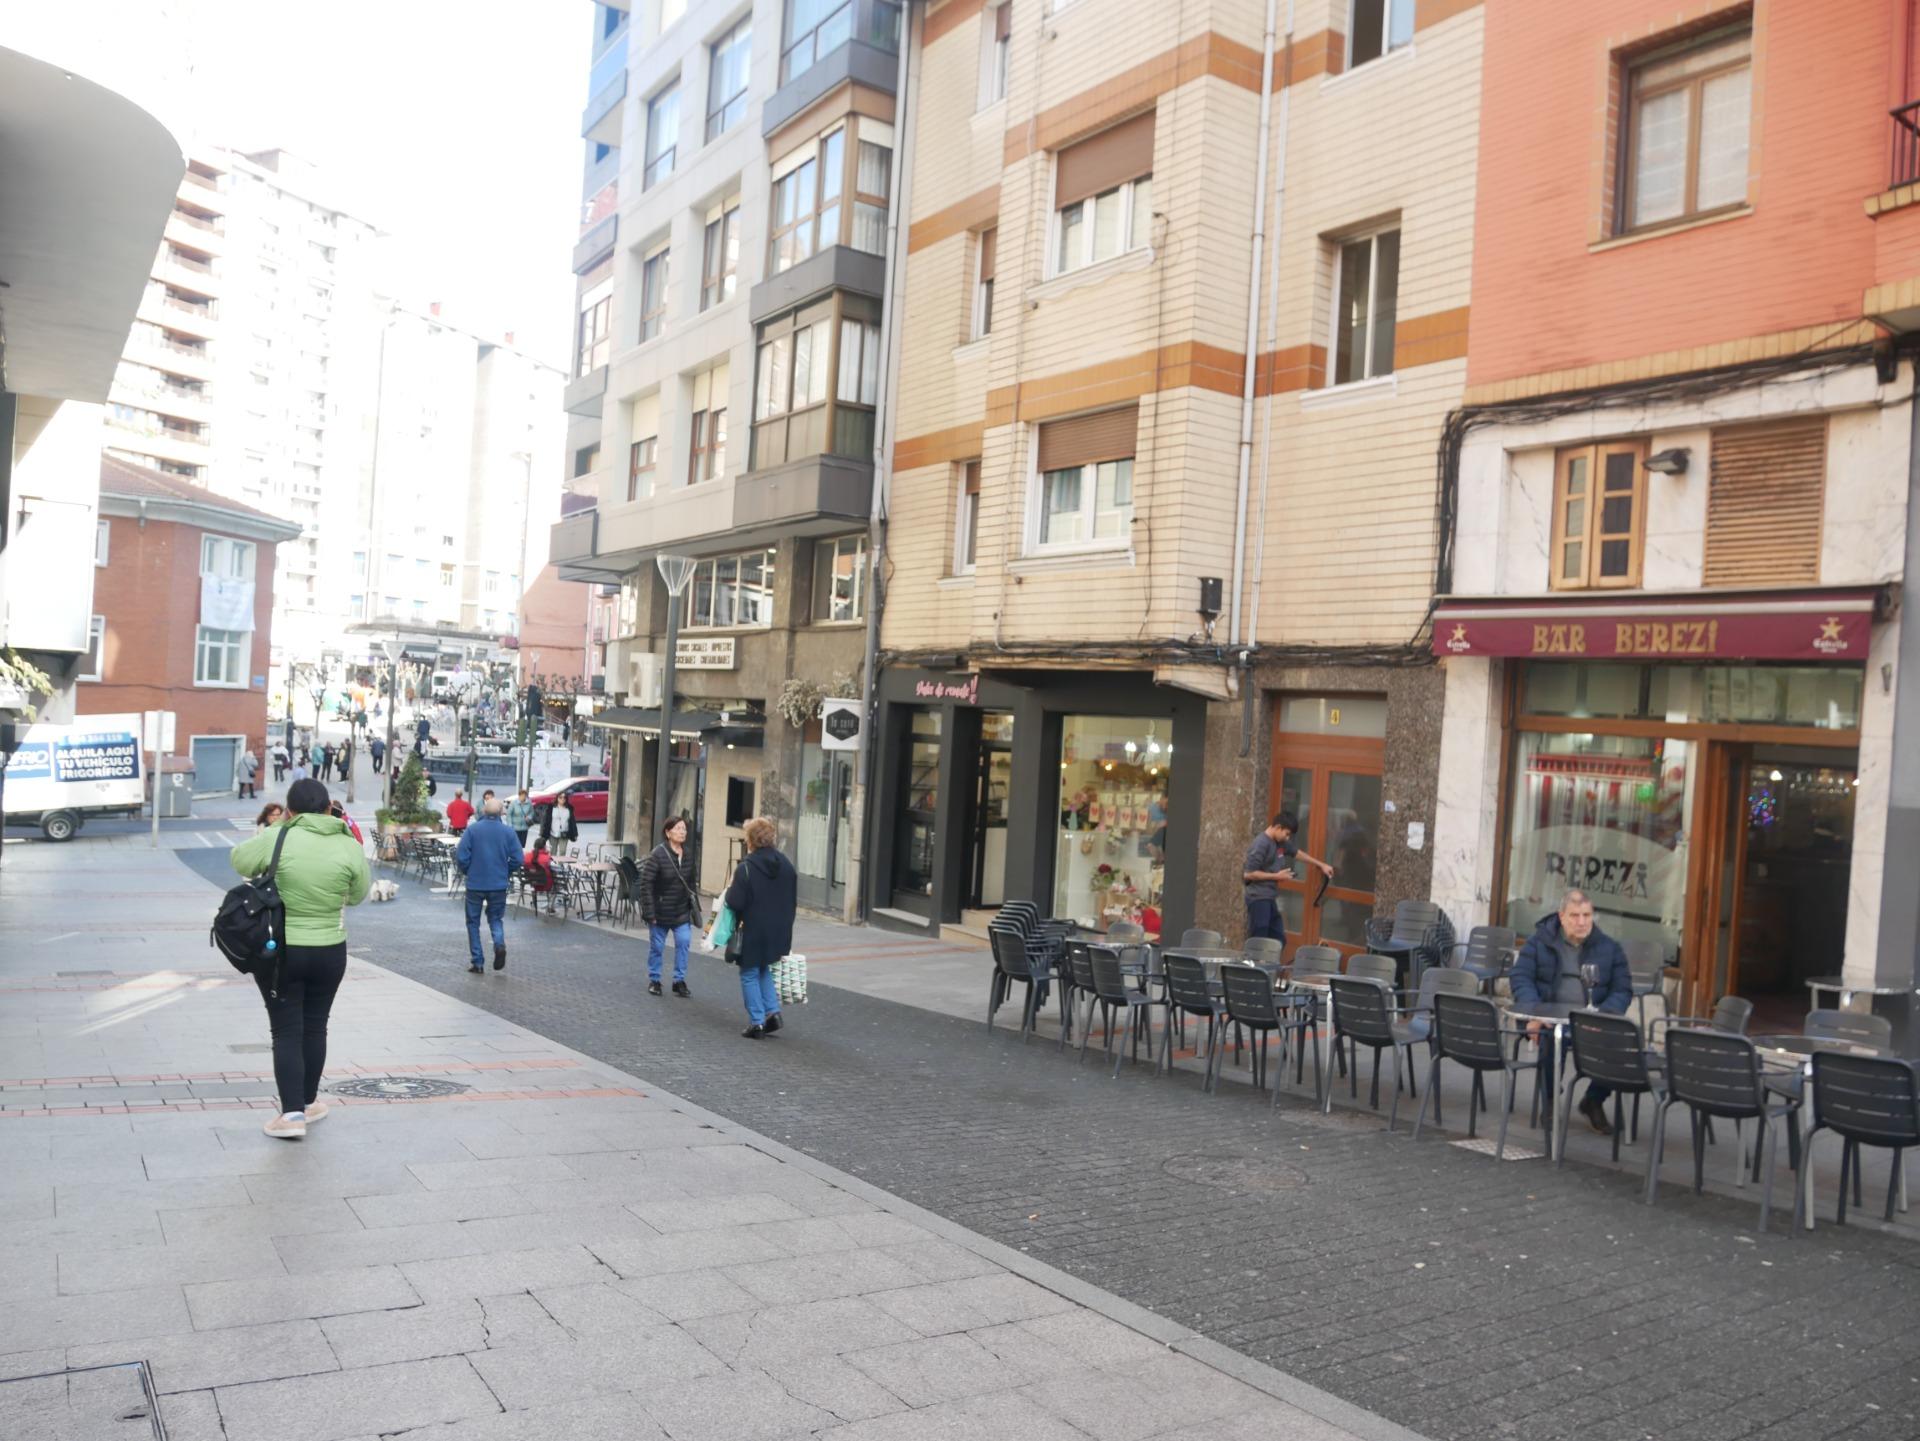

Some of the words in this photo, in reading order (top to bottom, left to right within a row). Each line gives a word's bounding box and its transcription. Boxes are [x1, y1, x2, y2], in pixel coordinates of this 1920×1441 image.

[1532, 623, 1586, 653] BAR
[56, 747, 105, 759] ALQUILA
[105, 744, 135, 757] AQUÍ
[58, 759, 75, 769] TU
[75, 756, 133, 769] VEHÍCULO
[59, 766, 133, 779] FRIGORÍFICO
